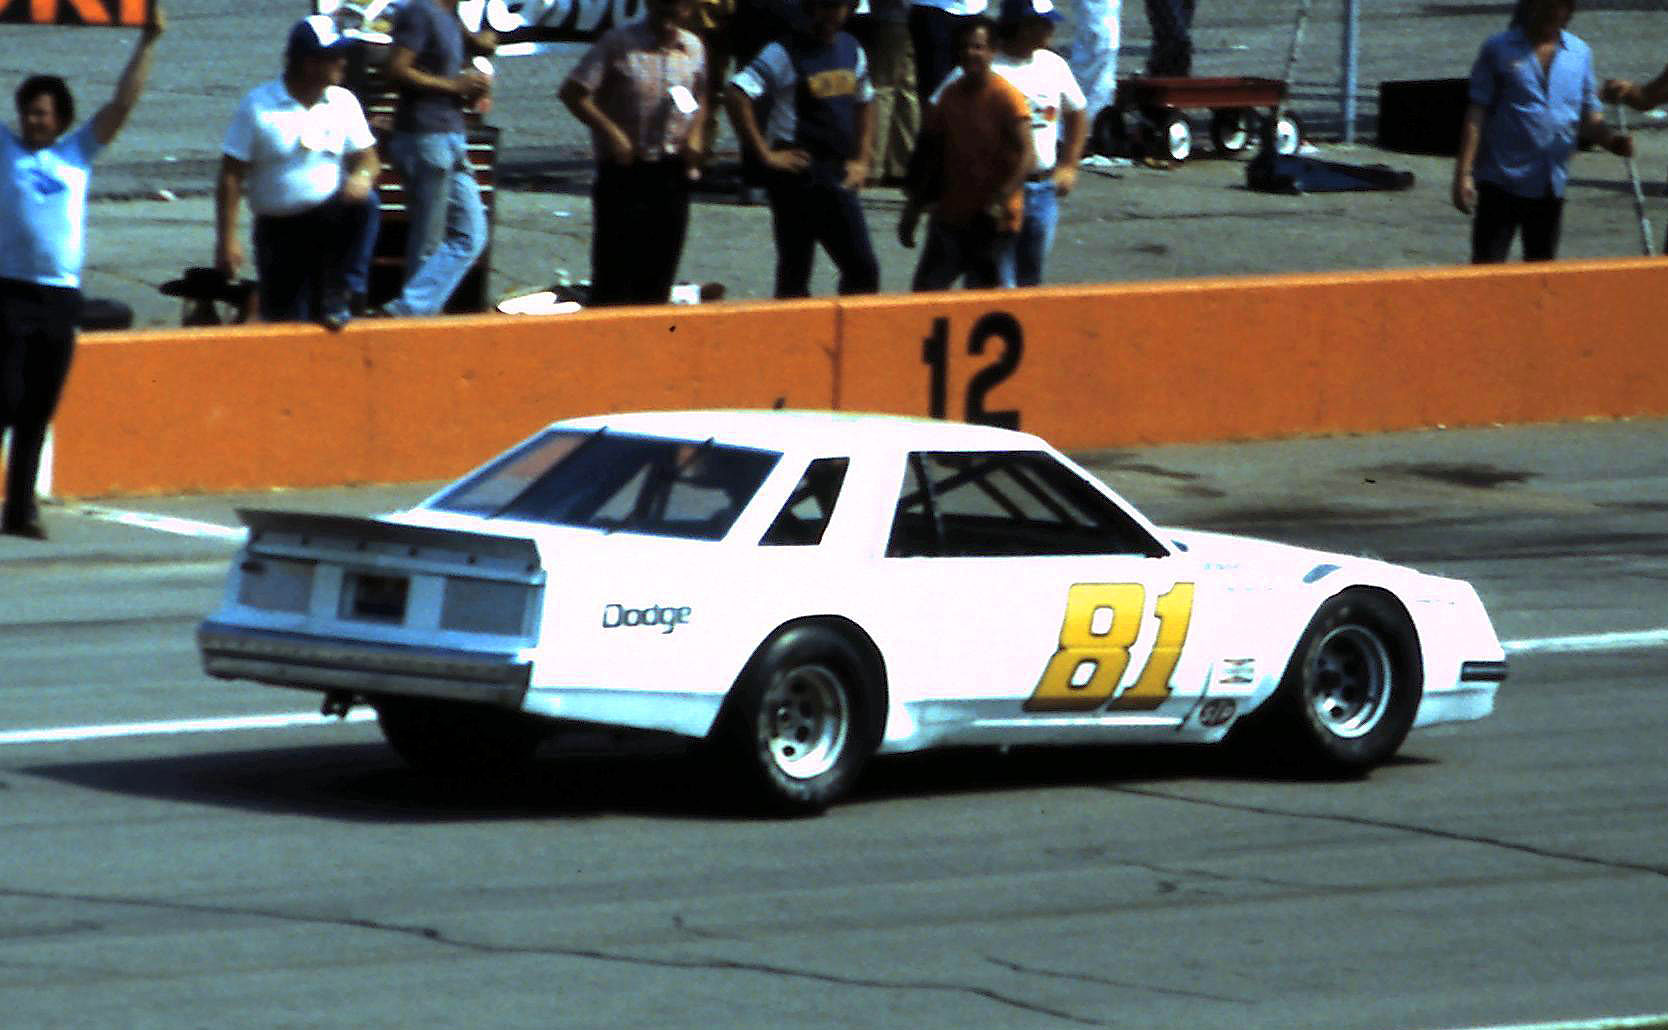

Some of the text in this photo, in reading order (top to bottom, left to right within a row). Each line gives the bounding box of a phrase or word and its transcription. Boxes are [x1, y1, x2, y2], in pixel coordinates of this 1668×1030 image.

[922, 311, 1023, 430] 12
[602, 603, 692, 634] Dodge
[1023, 582, 1195, 712] 81
